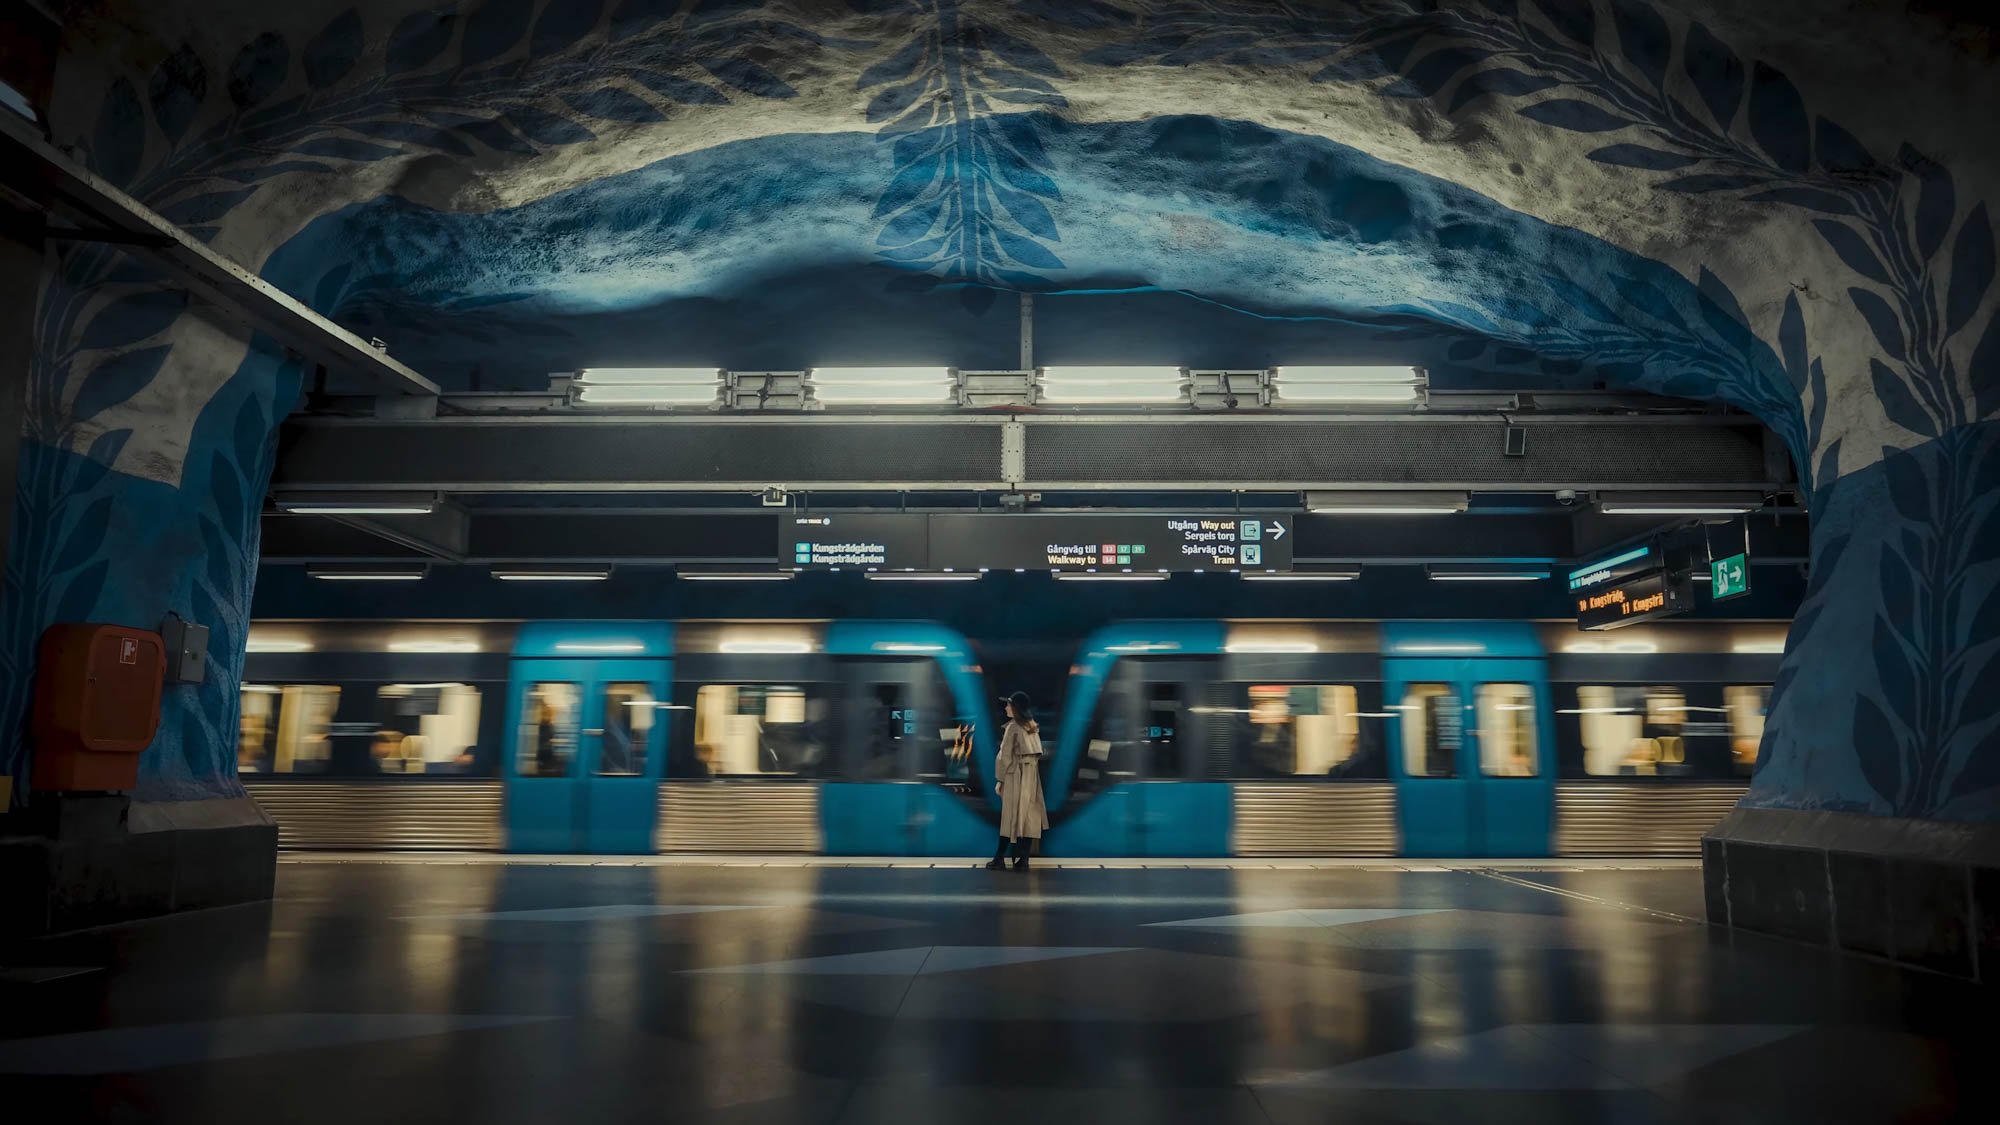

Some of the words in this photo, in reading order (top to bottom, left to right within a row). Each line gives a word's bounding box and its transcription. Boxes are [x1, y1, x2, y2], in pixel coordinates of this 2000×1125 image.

[1167, 520, 1198, 531] Utgång
[1200, 520, 1219, 531] Way
[1220, 520, 1235, 530] out
[1185, 531, 1216, 541] Sergels
[1217, 531, 1235, 541] torg
[812, 543, 884, 554] Kungsträdgården
[1047, 544, 1084, 555] Gångväg
[1085, 544, 1097, 554] till
[1181, 544, 1217, 555] Spårväg
[1218, 544, 1235, 555] City
[812, 554, 884, 564] Kungsträdgården
[1047, 555, 1086, 566] Walkway
[1087, 555, 1097, 565] to
[1212, 555, 1235, 565] Tram
[1622, 601, 1630, 615] 11
